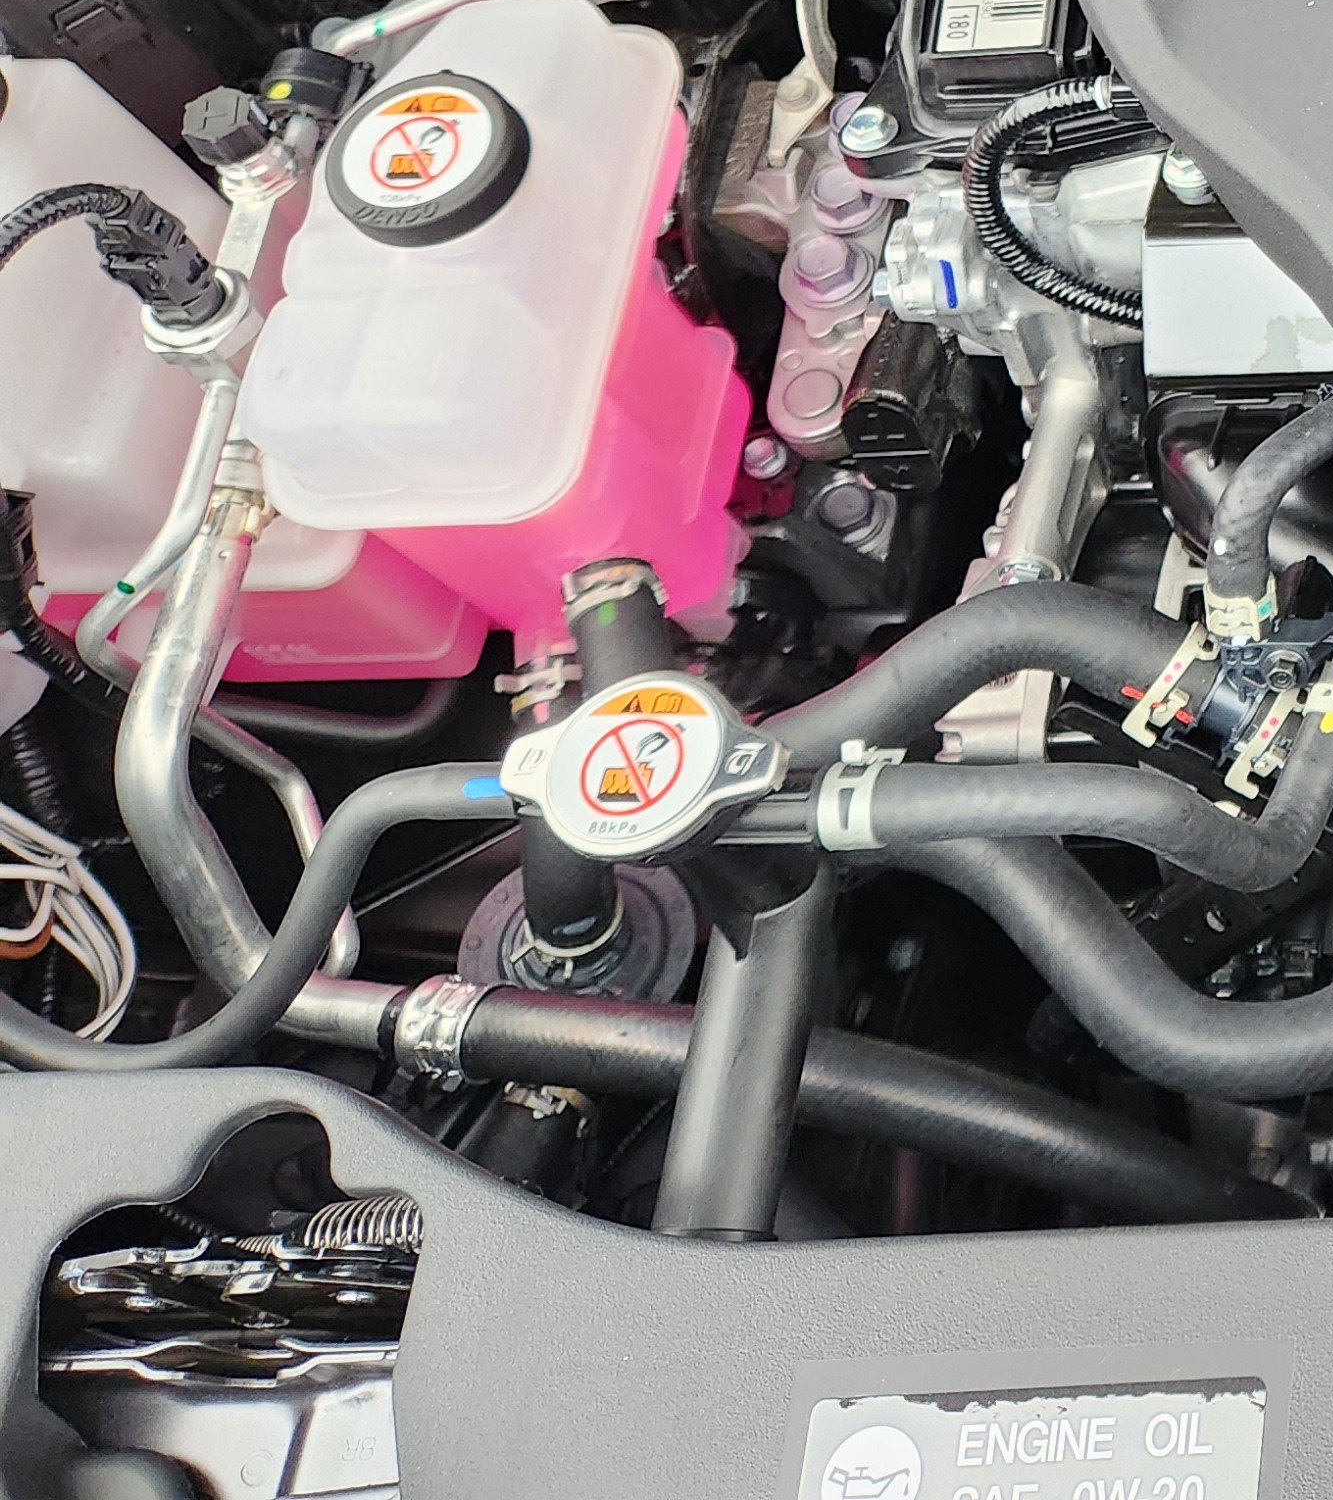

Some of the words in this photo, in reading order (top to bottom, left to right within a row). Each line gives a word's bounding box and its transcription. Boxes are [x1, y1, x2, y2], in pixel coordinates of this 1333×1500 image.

[947, 14, 969, 39] 180
[956, 1417, 1117, 1467] ENGINE
[1144, 1412, 1213, 1458] OIL
